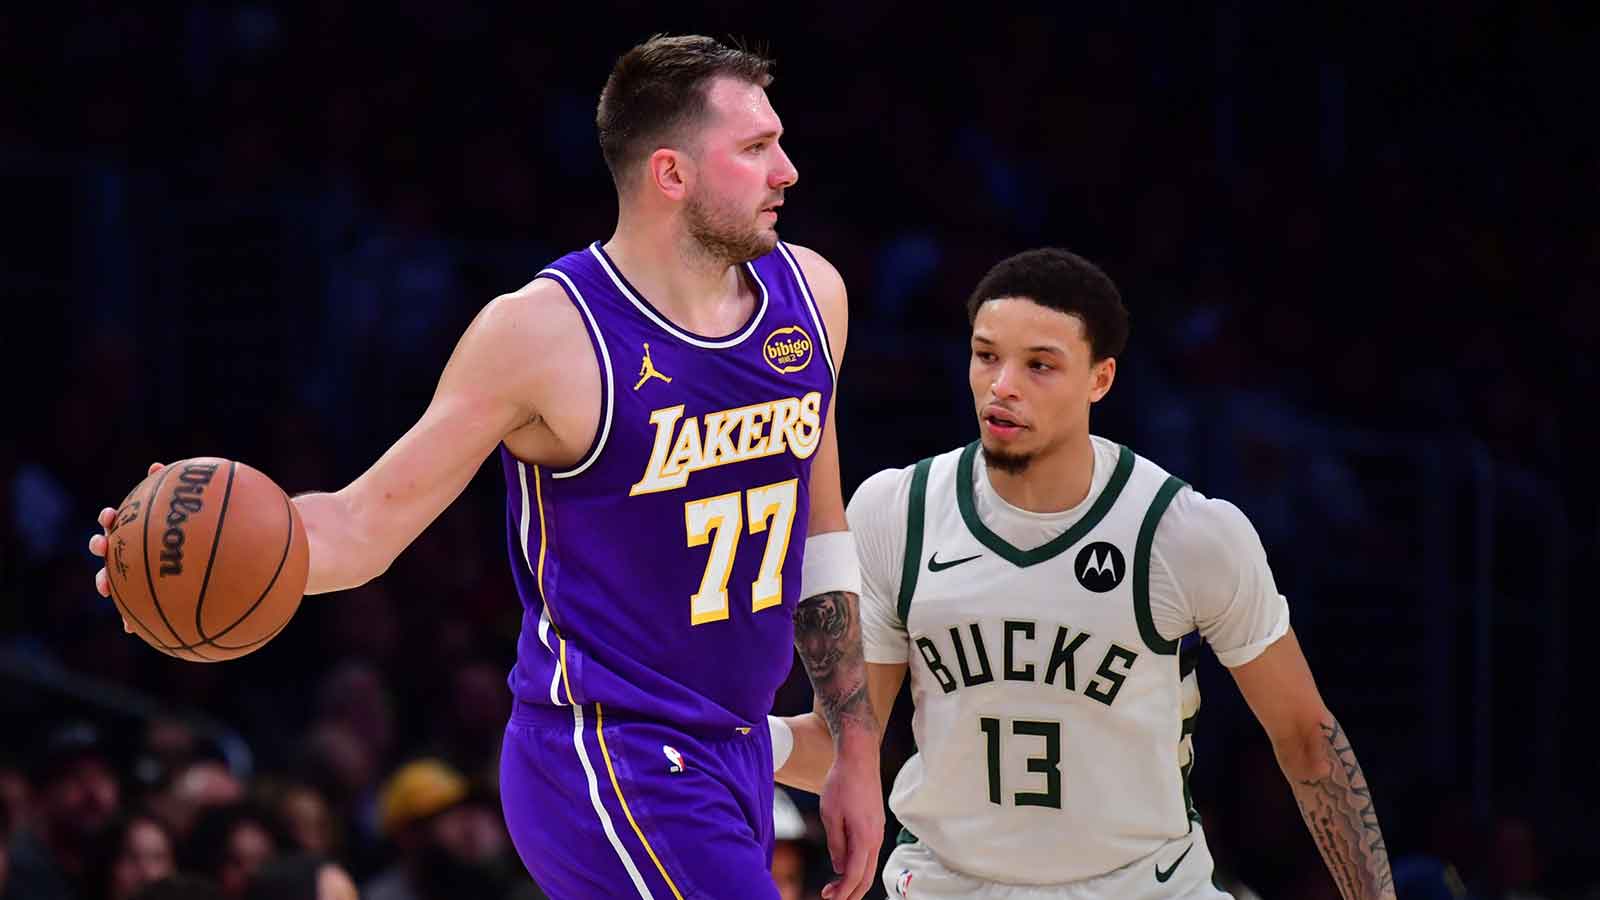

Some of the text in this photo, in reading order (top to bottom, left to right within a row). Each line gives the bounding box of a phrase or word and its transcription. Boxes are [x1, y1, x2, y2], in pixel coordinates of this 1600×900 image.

[767, 338, 809, 359] bibigo
[629, 391, 822, 497] LAKERS
[160, 463, 219, 578] Wilson
[684, 478, 799, 626] 77
[914, 619, 1139, 707] BUCKS
[979, 716, 1062, 810] 13
